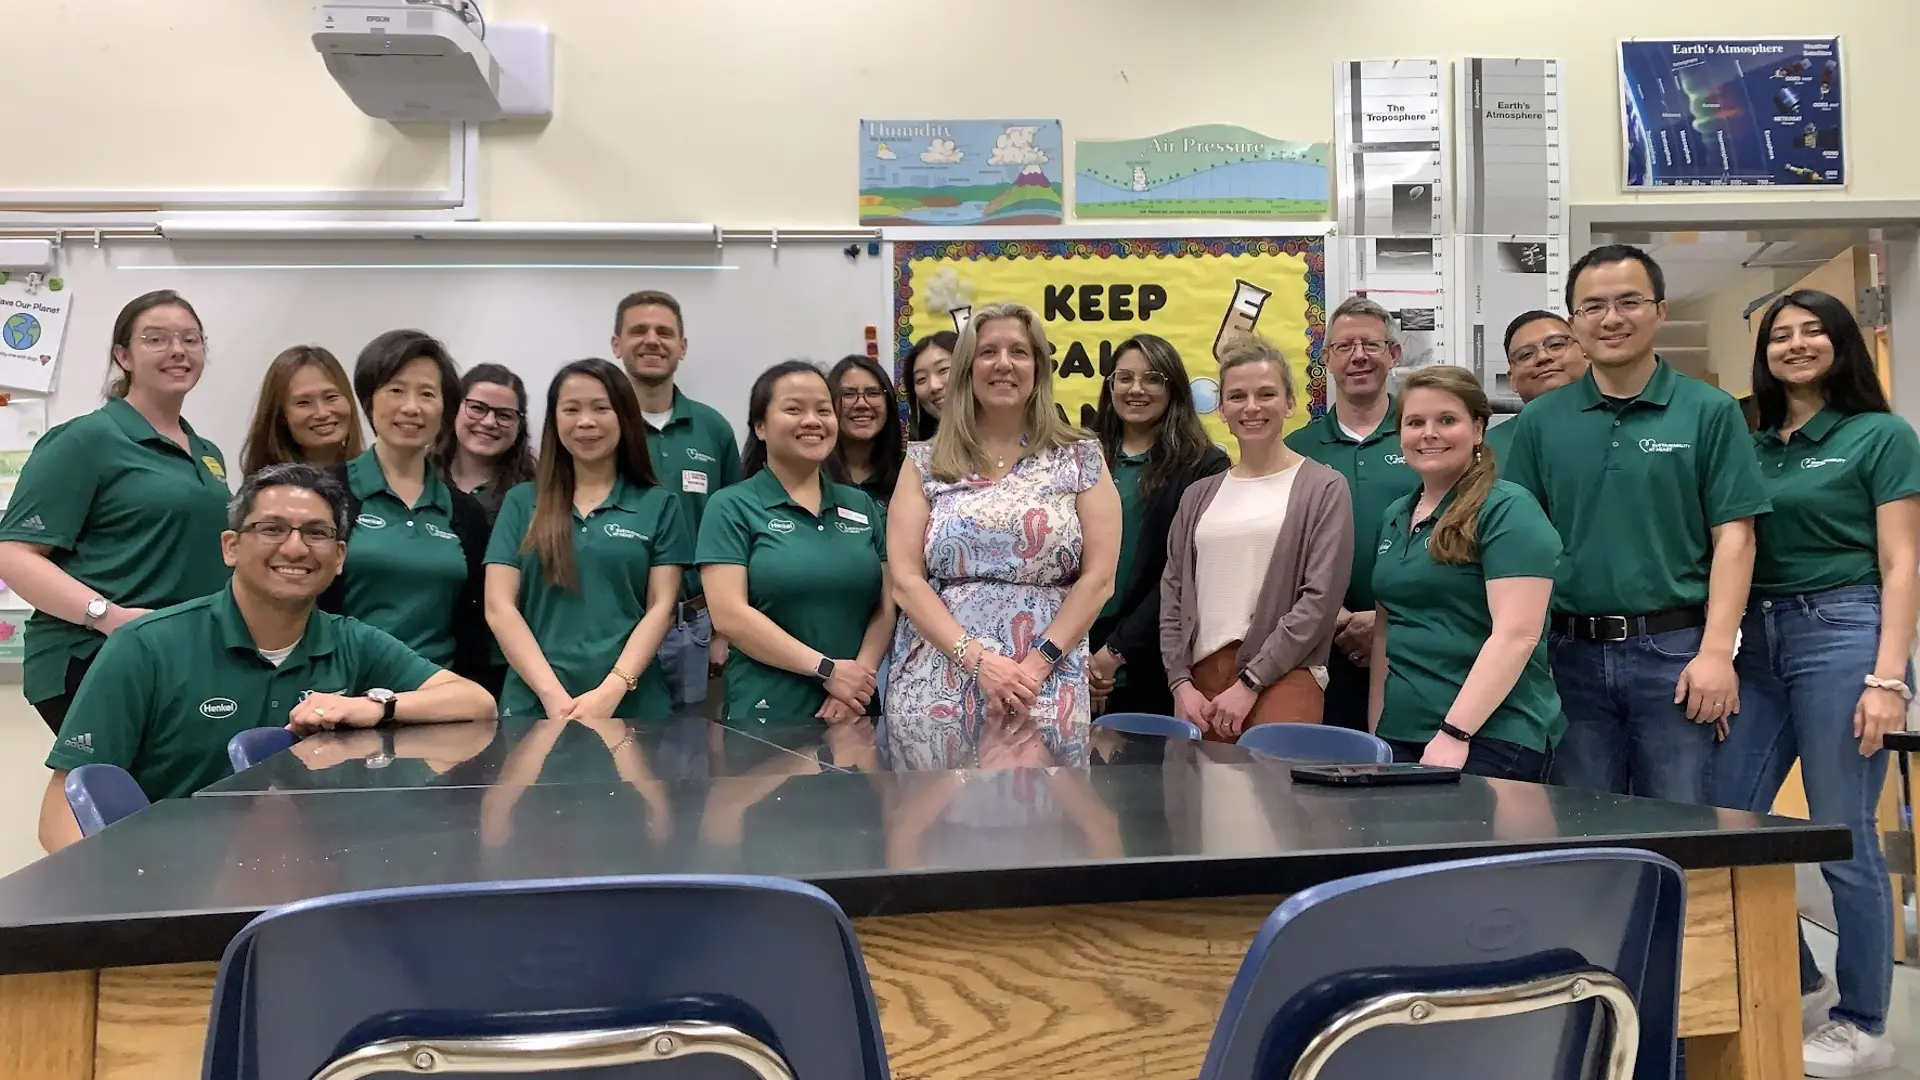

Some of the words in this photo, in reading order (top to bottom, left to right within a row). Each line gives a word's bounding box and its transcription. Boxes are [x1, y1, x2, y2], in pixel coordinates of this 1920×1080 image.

[1672, 44, 1714, 54] Earth's
[1716, 43, 1784, 55] Atmosphere
[1387, 104, 1405, 112] The
[1367, 114, 1426, 122] Troposphere
[1486, 111, 1543, 120] Atmosphere
[869, 122, 951, 136] Humidity
[1140, 138, 1175, 158] Air
[1183, 138, 1264, 153] Pressure
[1717, 130, 1728, 170] Thermosphere
[15, 300, 31, 309] Our
[33, 303, 60, 314] Planet
[1044, 284, 1167, 321] KEEP
[204, 703, 233, 713] Henkel
[65, 739, 95, 754] adidas
